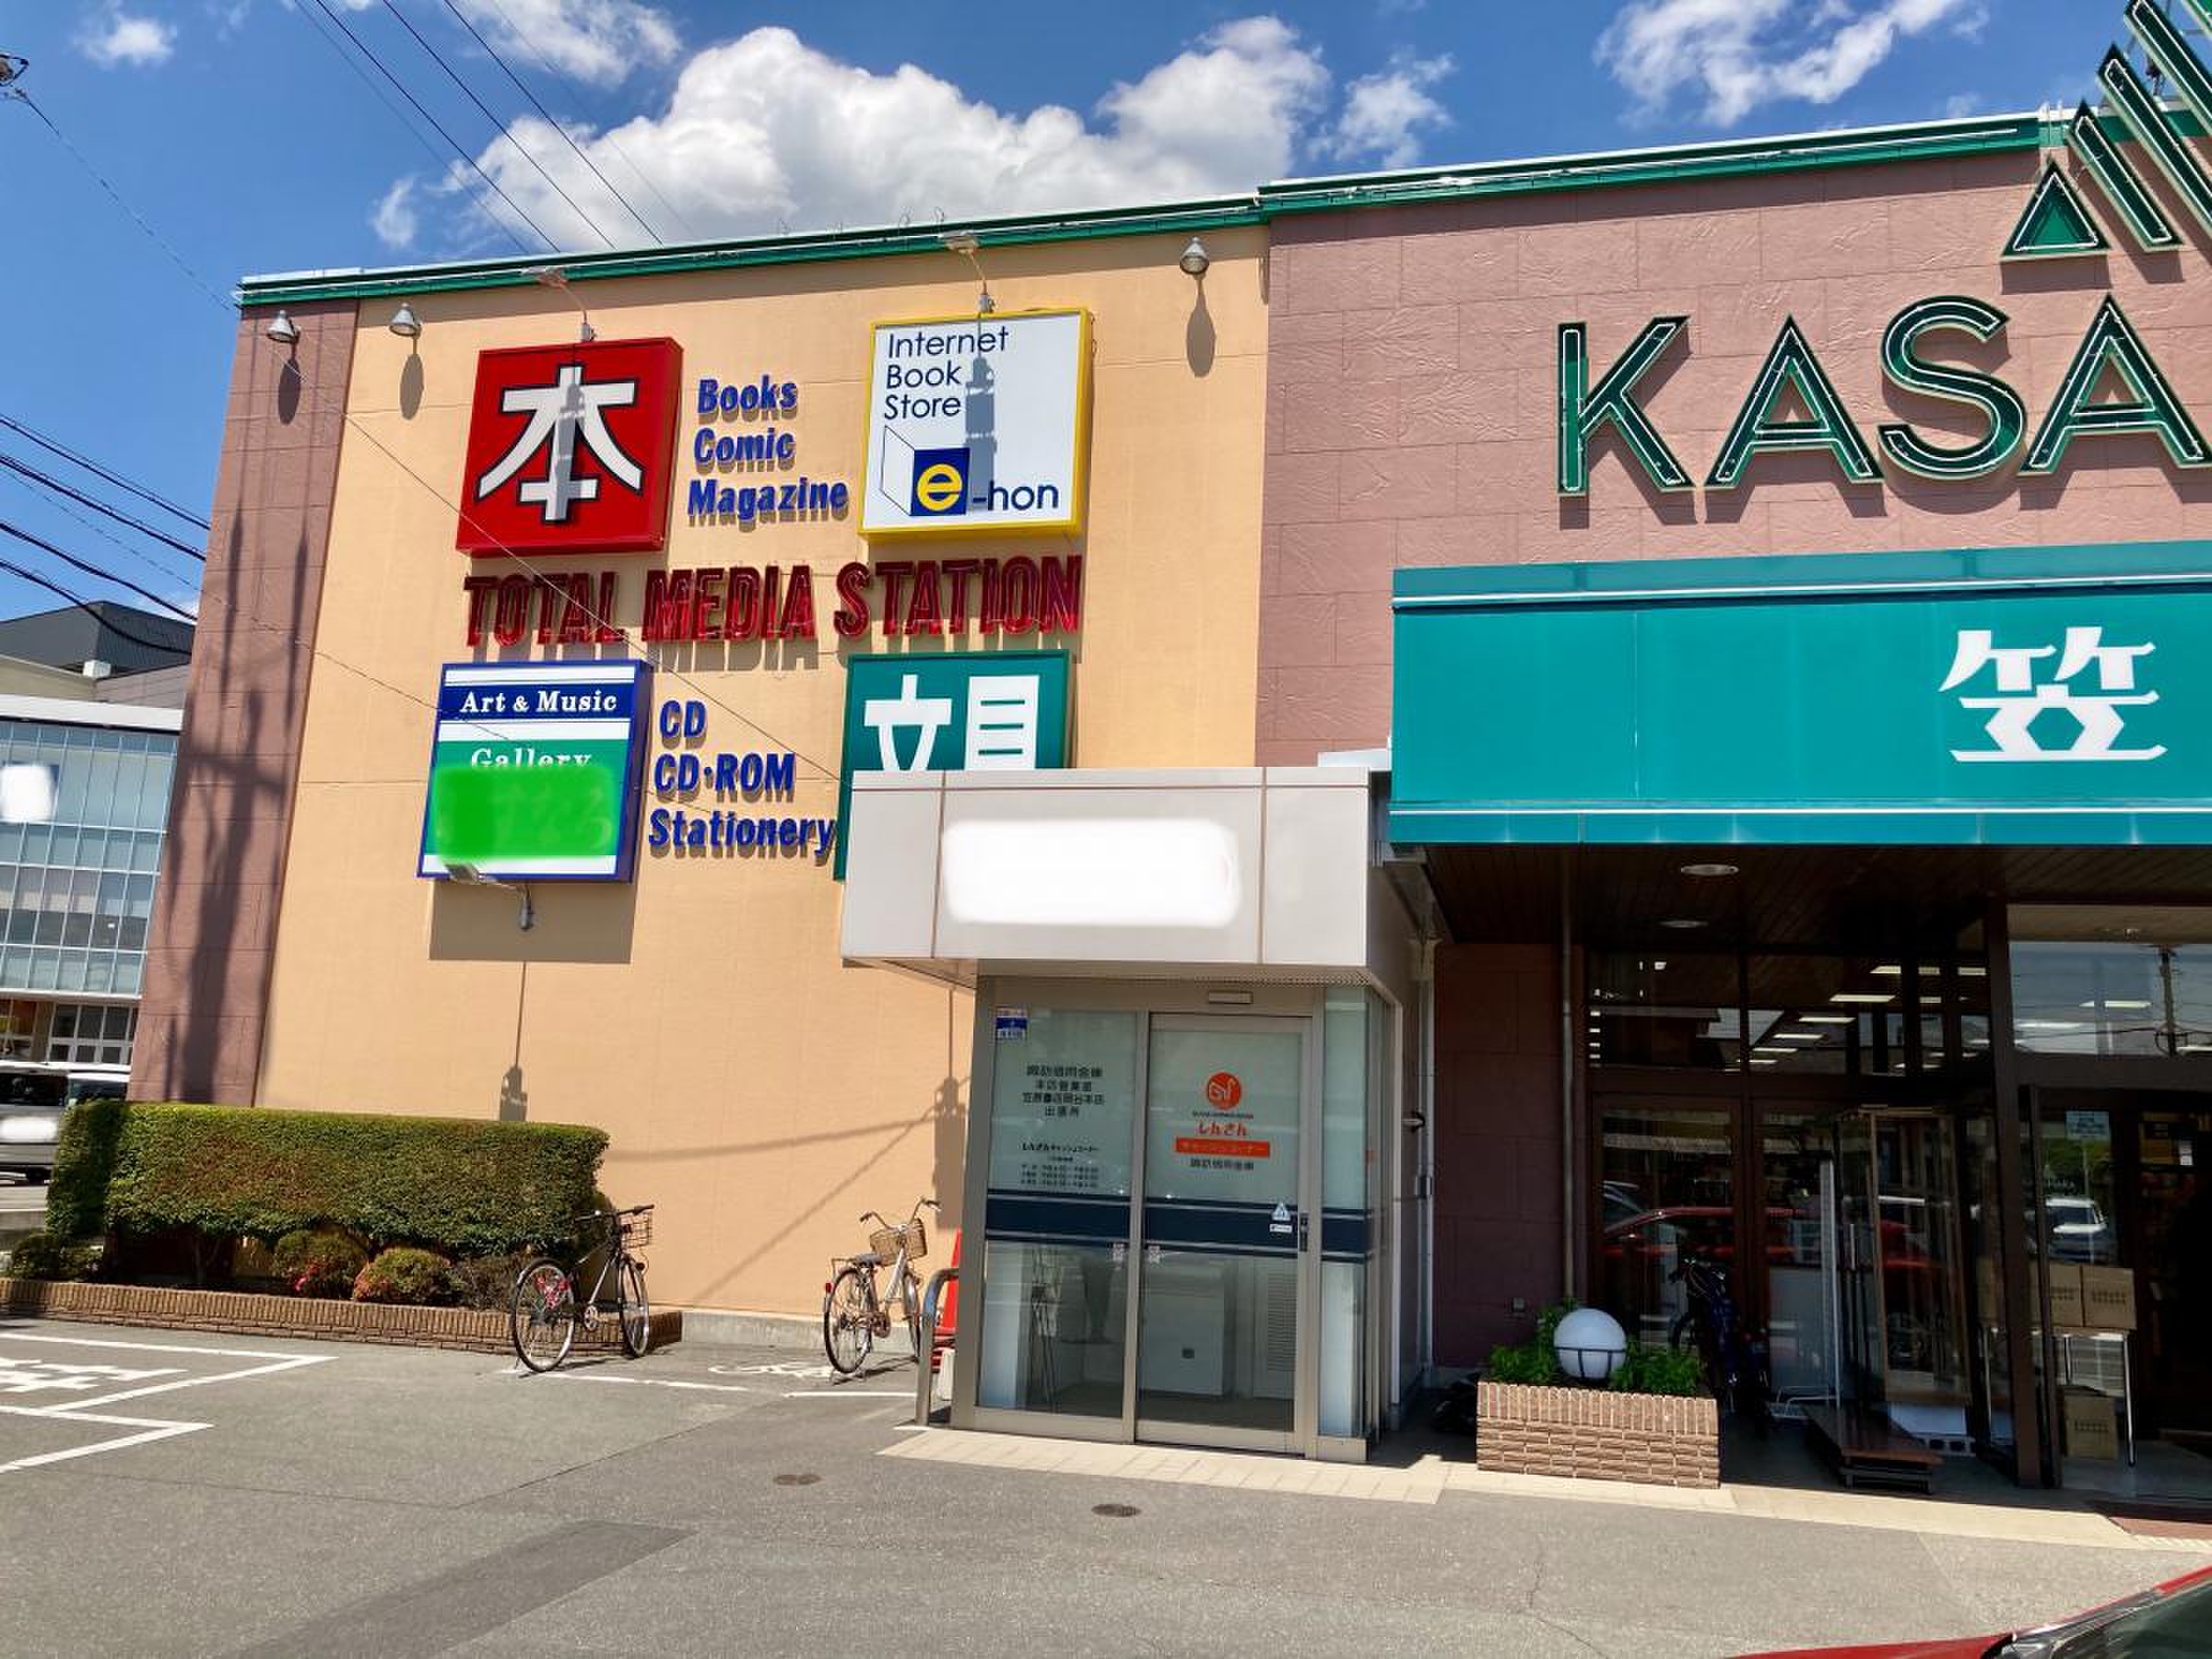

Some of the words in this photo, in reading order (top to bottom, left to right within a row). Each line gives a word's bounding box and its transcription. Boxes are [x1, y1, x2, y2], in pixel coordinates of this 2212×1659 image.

[888, 326, 1009, 359] Internet
[698, 374, 798, 414] Books
[886, 360, 962, 389] Book
[884, 394, 961, 420] Store
[476, 364, 646, 524] 本
[694, 427, 796, 464] Comic
[688, 477, 849, 521] Magazine
[463, 571, 627, 647] TOTAL
[641, 564, 817, 645] MEDIA
[832, 555, 1083, 642] STATION
[459, 690, 506, 713] Art
[512, 695, 530, 712] &
[535, 689, 618, 712] Music
[1938, 626, 2169, 762] 笠
[659, 700, 707, 738] CD
[649, 808, 836, 856] Stationery
